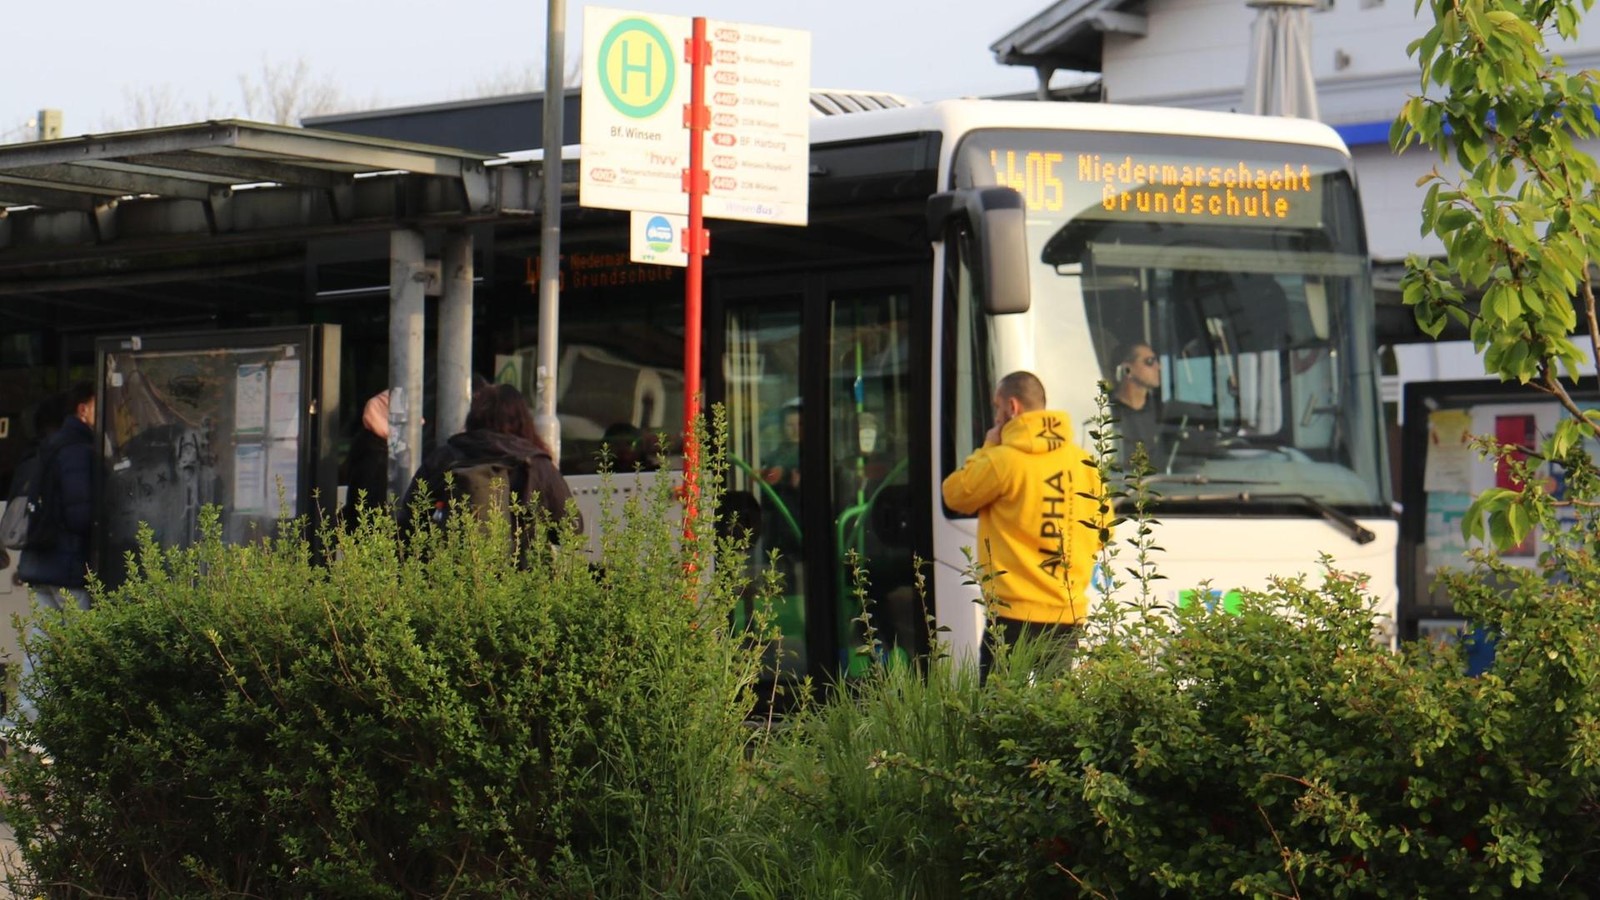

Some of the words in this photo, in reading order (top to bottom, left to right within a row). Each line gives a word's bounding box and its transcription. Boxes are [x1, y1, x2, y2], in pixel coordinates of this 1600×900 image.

[621, 40, 653, 97] H
[610, 127, 625, 138] Bf.
[626, 128, 661, 141] Winsen
[754, 138, 786, 152] Harburg
[650, 152, 678, 166] hvv
[1078, 154, 1312, 192] Niedermarschacht
[1102, 183, 1289, 218] Grundschule
[573, 266, 674, 288] Grundschule
[1038, 470, 1065, 580] ALPHA
